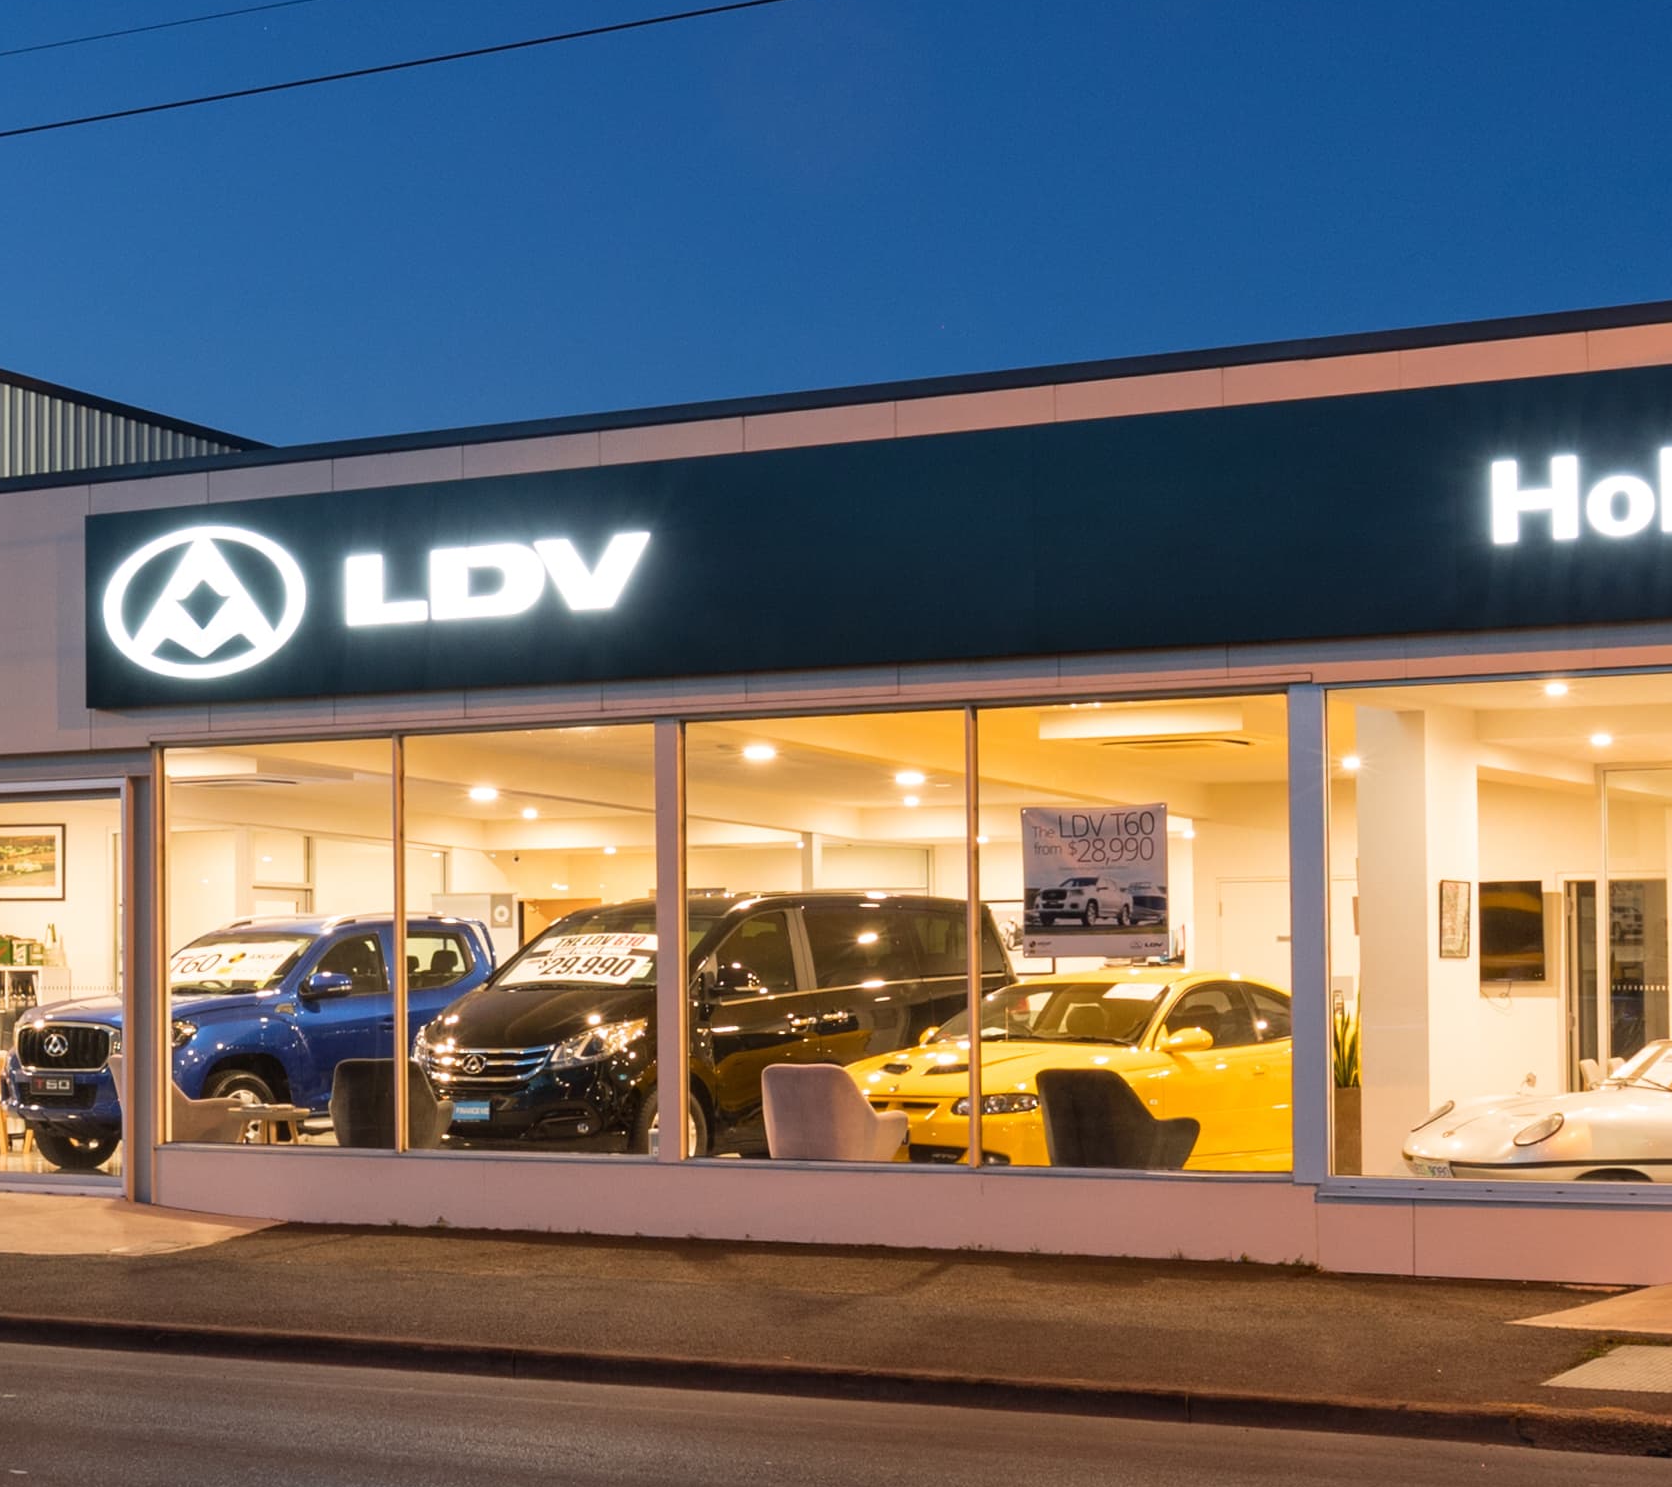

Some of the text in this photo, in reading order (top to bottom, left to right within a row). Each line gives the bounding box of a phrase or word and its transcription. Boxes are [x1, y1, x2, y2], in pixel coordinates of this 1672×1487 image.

[345, 531, 651, 627] LDV
[1032, 826, 1055, 839] The
[1058, 811, 1155, 839] LDV T60
[1033, 837, 1154, 865] from $28,990
